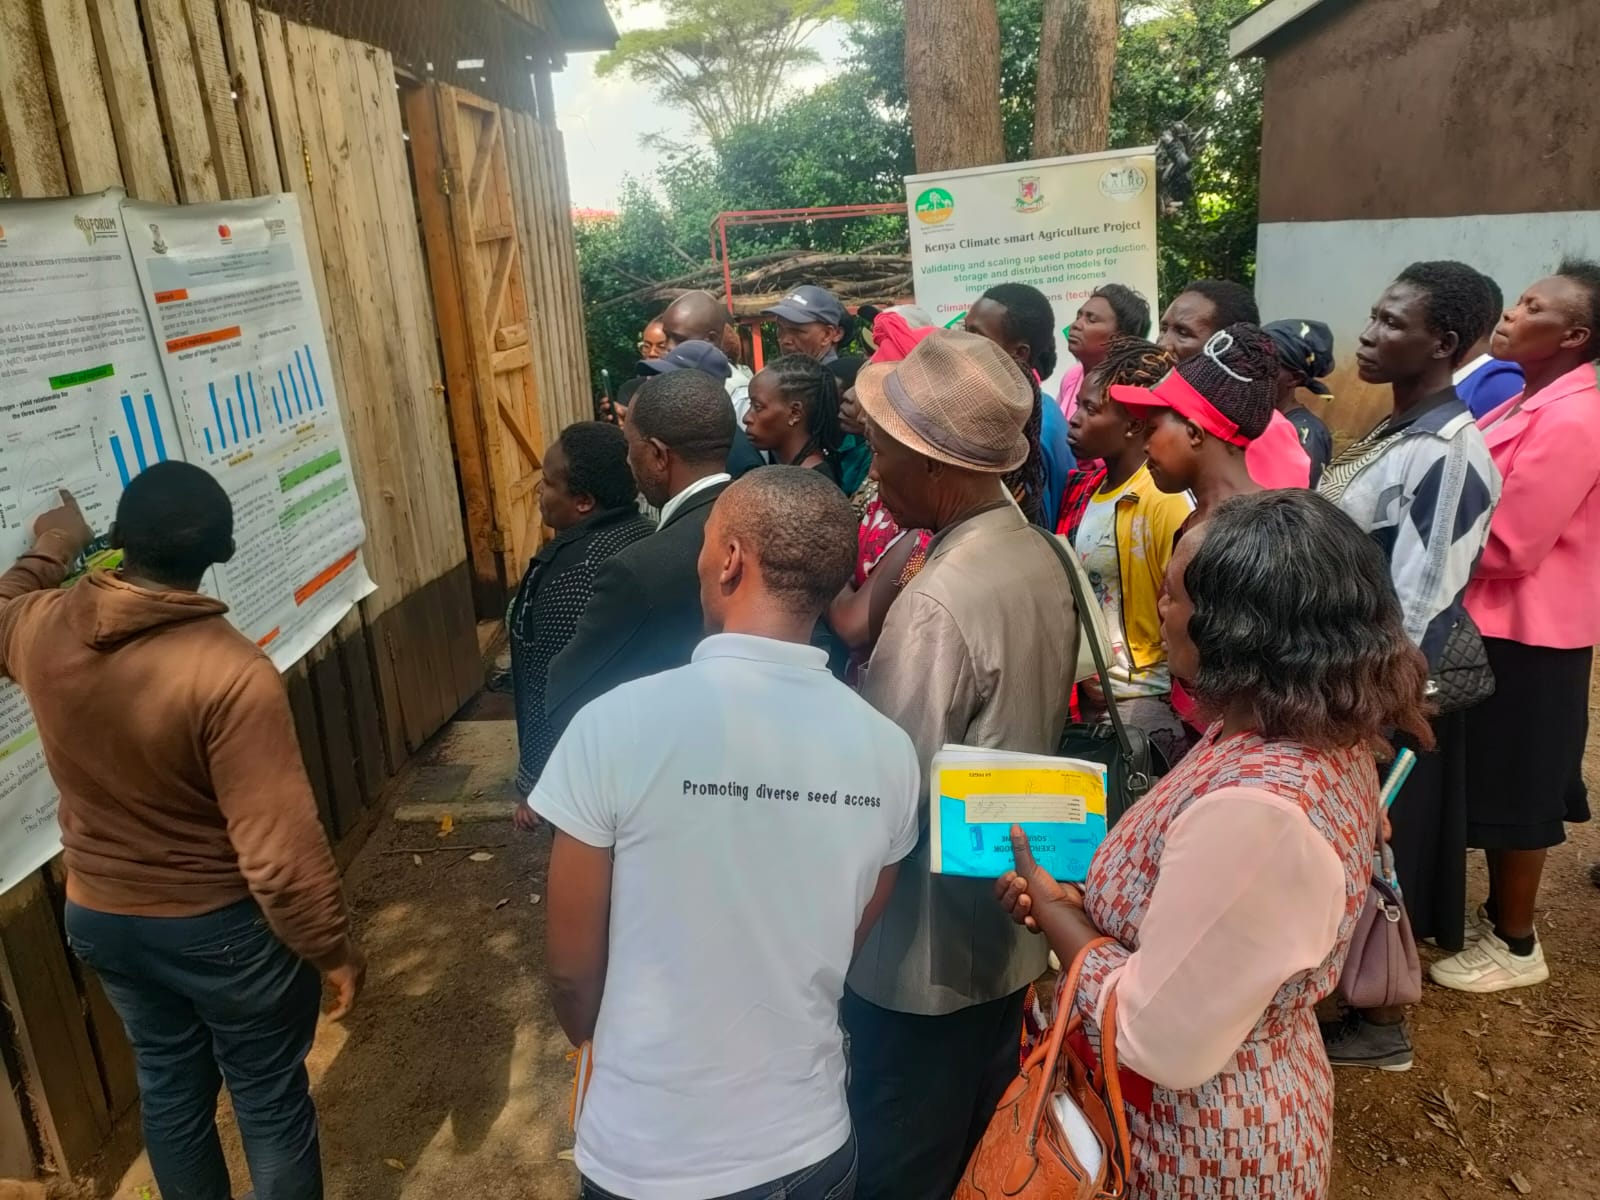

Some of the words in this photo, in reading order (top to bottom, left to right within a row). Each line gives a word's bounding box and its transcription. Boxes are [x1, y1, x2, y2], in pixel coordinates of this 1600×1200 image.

[924, 242, 956, 254] Kenya
[959, 236, 1001, 249] Climate
[1004, 232, 1034, 244] smart
[1039, 225, 1100, 241] Agriculture
[1103, 220, 1141, 233] Project
[920, 262, 965, 275] Validating
[968, 260, 985, 269] and
[987, 256, 1021, 267] scaling
[1023, 255, 1035, 264] up
[1039, 251, 1061, 261] seed
[1063, 248, 1094, 261] potato
[953, 271, 988, 283] storage
[991, 268, 1008, 278] and
[1011, 263, 1064, 276] distribution
[1067, 258, 1101, 270] models
[1104, 256, 1117, 266] for
[965, 282, 1001, 293] impro
[1046, 273, 1064, 284] and
[1066, 271, 1106, 281] incomes
[682, 779, 749, 801] Promoting
[756, 783, 800, 801] diverse
[807, 790, 838, 805] seed
[844, 793, 881, 808] access
[1024, 844, 1056, 853] EXERC
